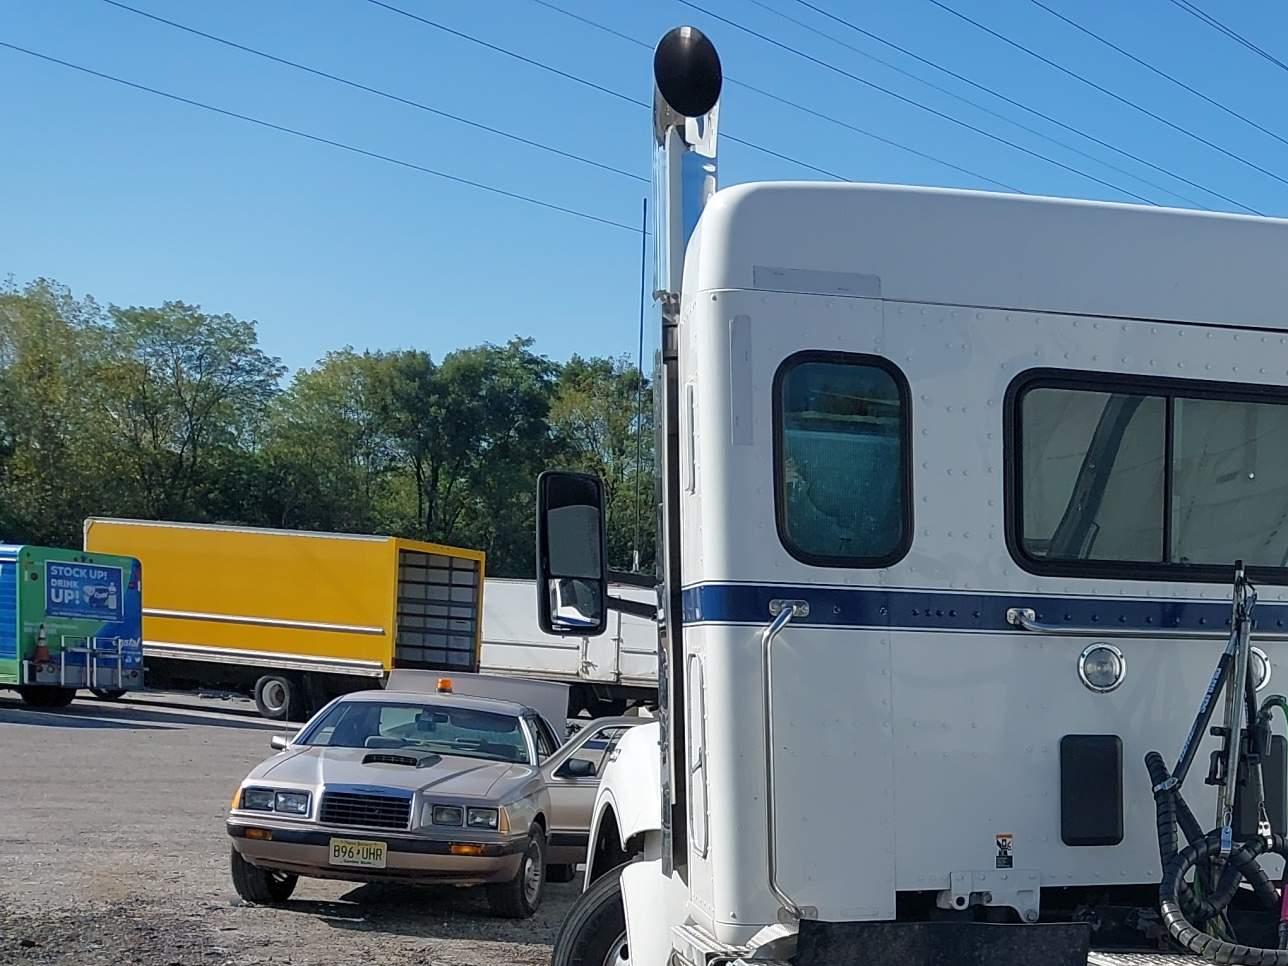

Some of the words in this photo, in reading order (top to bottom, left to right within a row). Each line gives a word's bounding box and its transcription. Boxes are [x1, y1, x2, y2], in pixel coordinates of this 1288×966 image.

[50, 566, 87, 578] STOCK
[89, 569, 107, 580] UP!
[50, 578, 79, 588] DRINK
[50, 588, 80, 604] UP!
